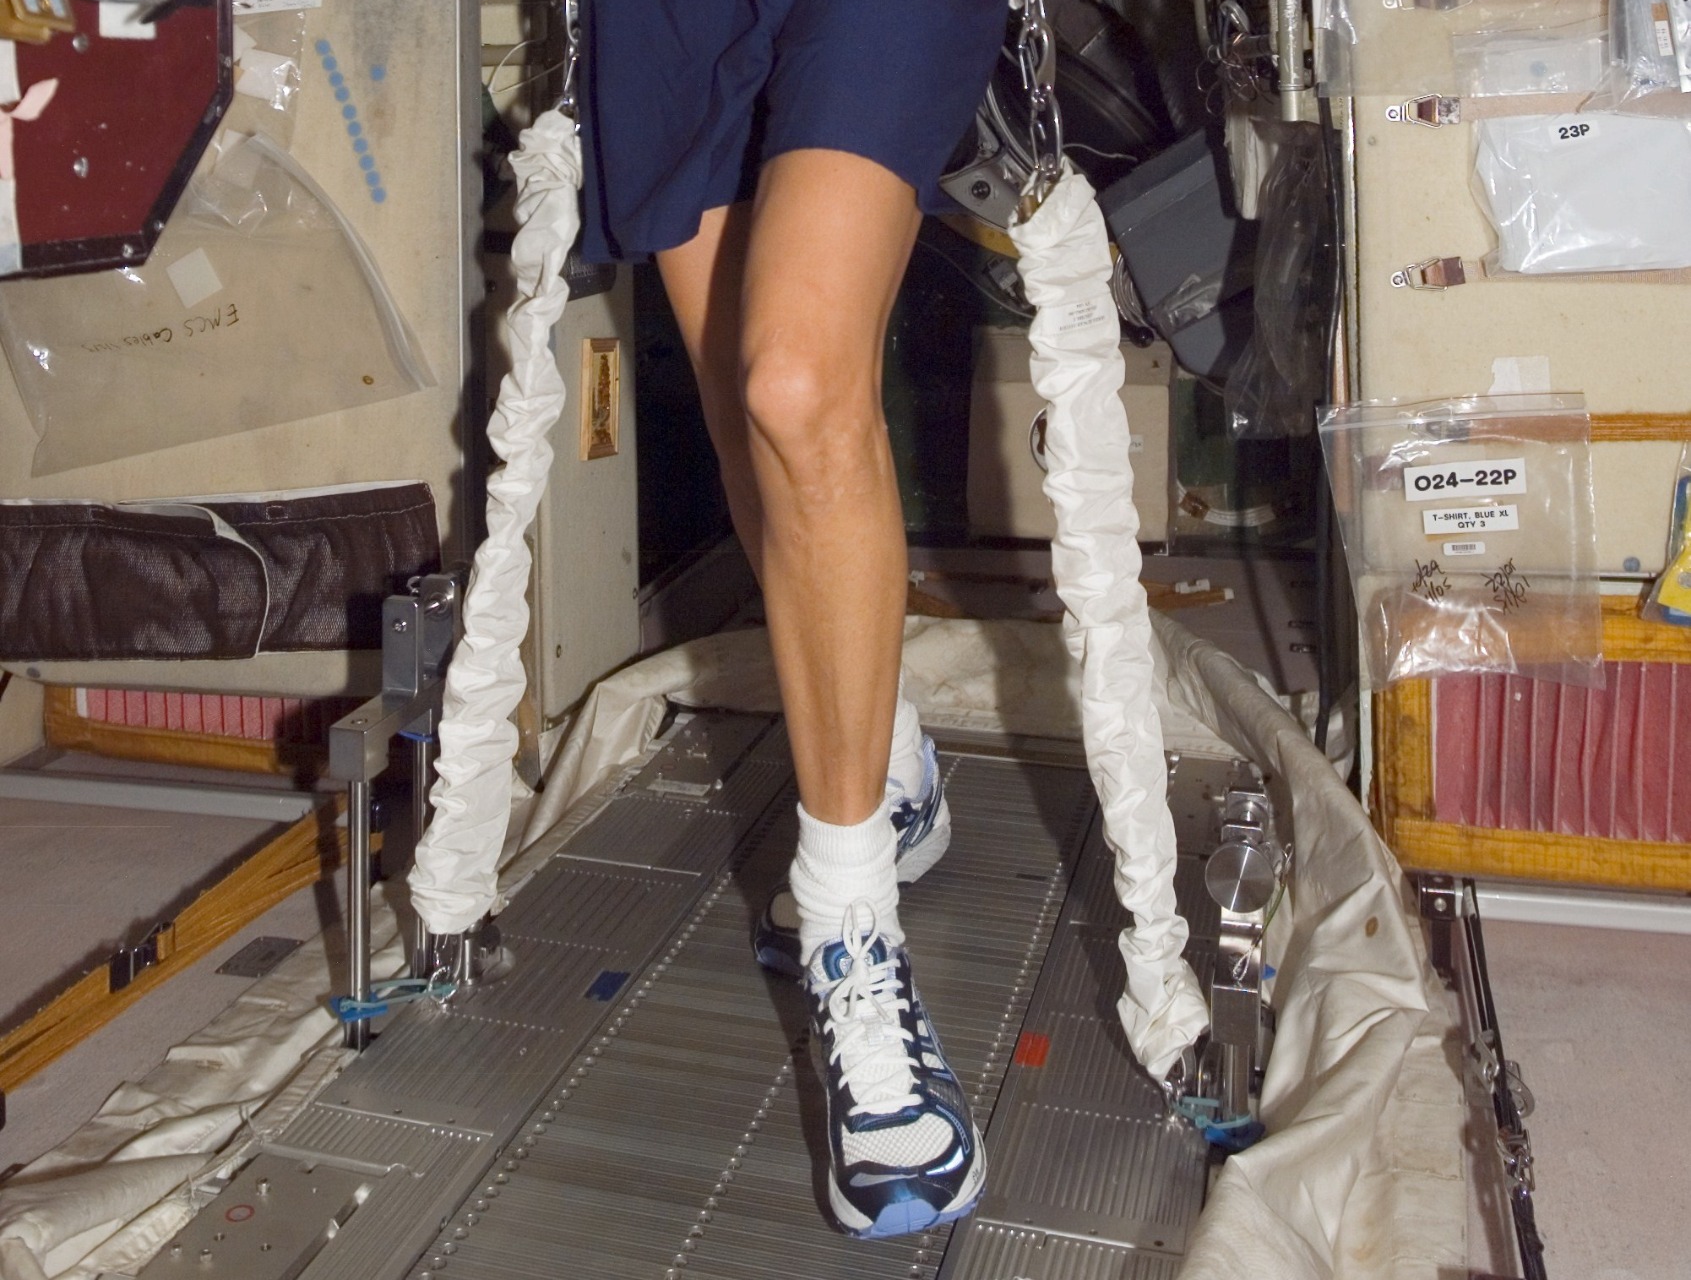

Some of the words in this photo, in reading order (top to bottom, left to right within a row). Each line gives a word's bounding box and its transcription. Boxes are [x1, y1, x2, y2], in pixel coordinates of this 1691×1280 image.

[1558, 123, 1591, 140] 23P
[122, 327, 174, 350] Cables
[1414, 469, 1517, 492] O24-22P
[1474, 511, 1495, 519] BLUE
[1458, 521, 1476, 529] QTY
[1480, 520, 1486, 528] 3
